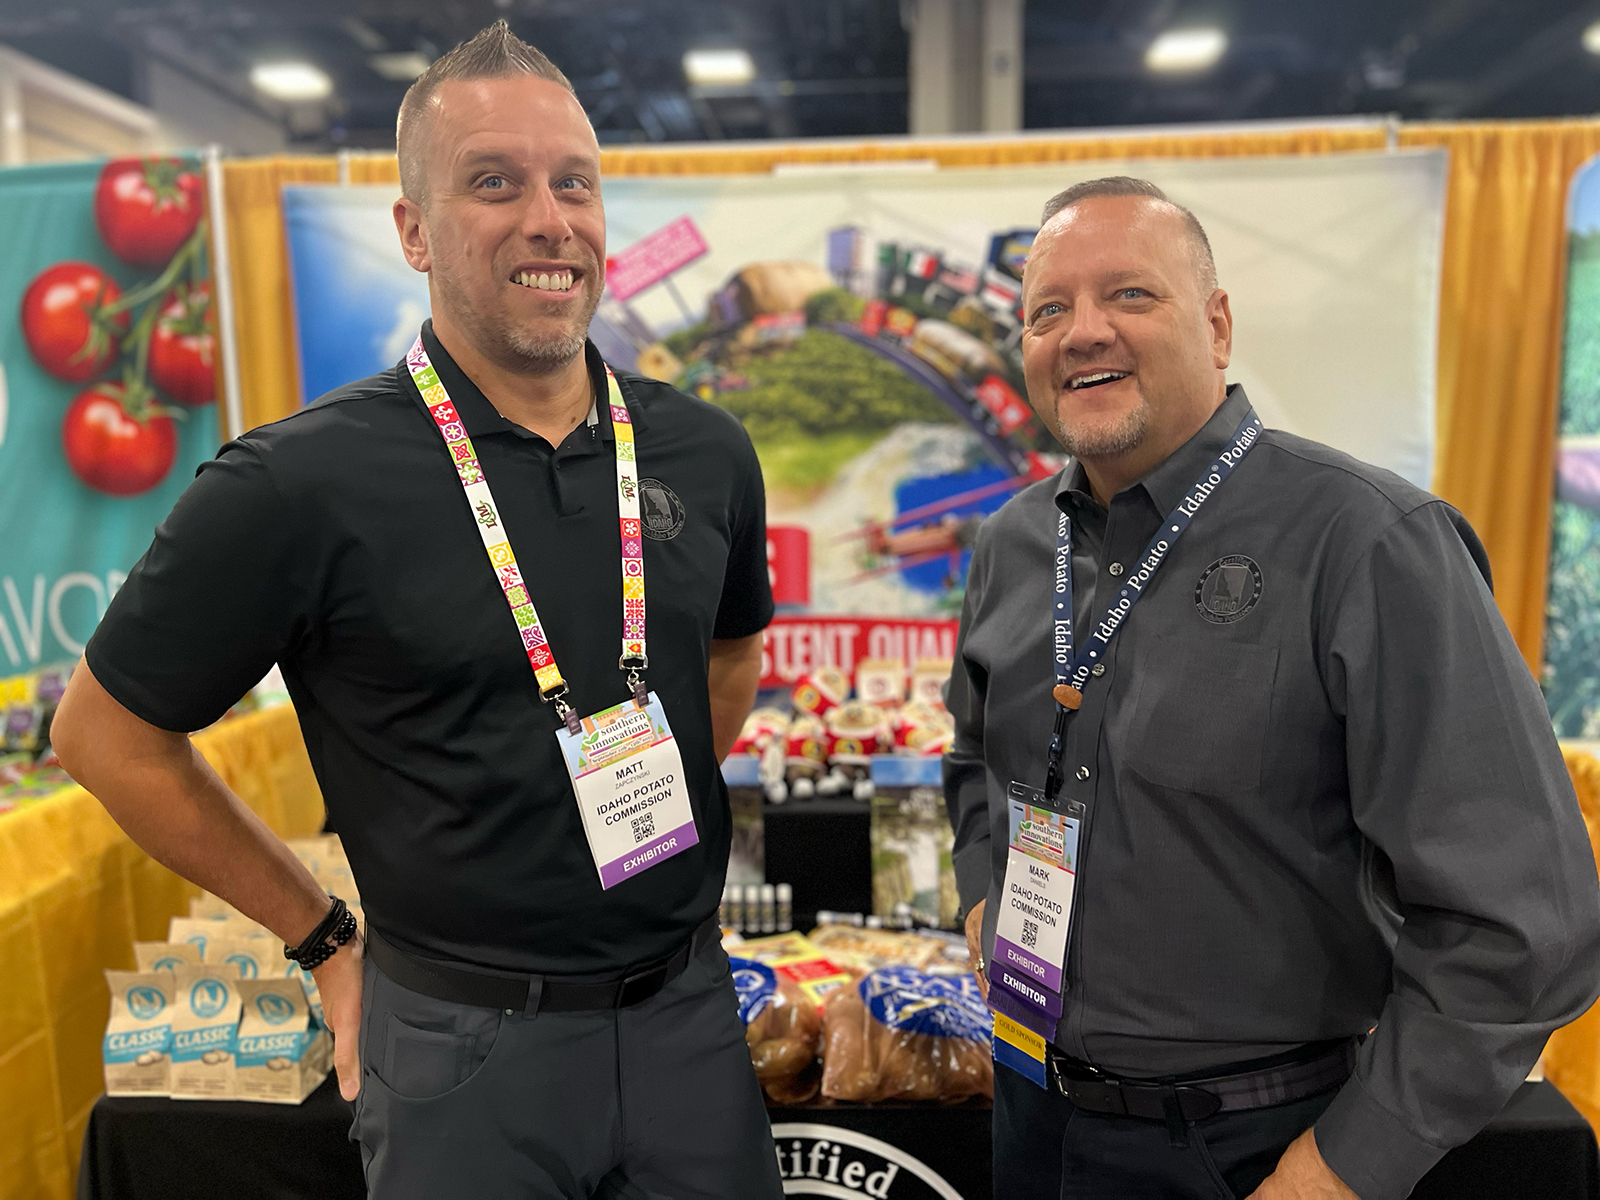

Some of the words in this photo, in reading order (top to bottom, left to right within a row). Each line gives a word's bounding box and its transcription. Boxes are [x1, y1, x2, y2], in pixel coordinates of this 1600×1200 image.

[1127, 540, 1169, 592] Potato
[1219, 426, 1257, 469] Potato
[1055, 543, 1070, 594] Potato
[591, 721, 649, 751] innovations
[601, 712, 646, 736] southern
[615, 760, 644, 780] MATT
[596, 793, 631, 816] IDAHO
[633, 774, 674, 799] POTATO
[605, 788, 672, 826] COMMISSION
[1024, 829, 1062, 849] innovations
[1032, 822, 1063, 840] southern
[623, 837, 678, 872] EXHIBITOR
[1029, 864, 1050, 881] MARK
[1010, 882, 1033, 901] IDAHO
[1034, 893, 1062, 915] POTATO
[1011, 897, 1057, 928] COMMISSION
[1007, 949, 1045, 978] EXHIBITOR
[1003, 972, 1047, 1007] EXHIBITOR
[108, 1026, 168, 1050] CLASSIC
[175, 1026, 231, 1048] CLASSIC
[239, 1034, 298, 1055] CLASSIC
[999, 1019, 1016, 1034] GOLD
[1016, 1028, 1043, 1050] SPONSOR
[775, 1140, 900, 1200] tified
